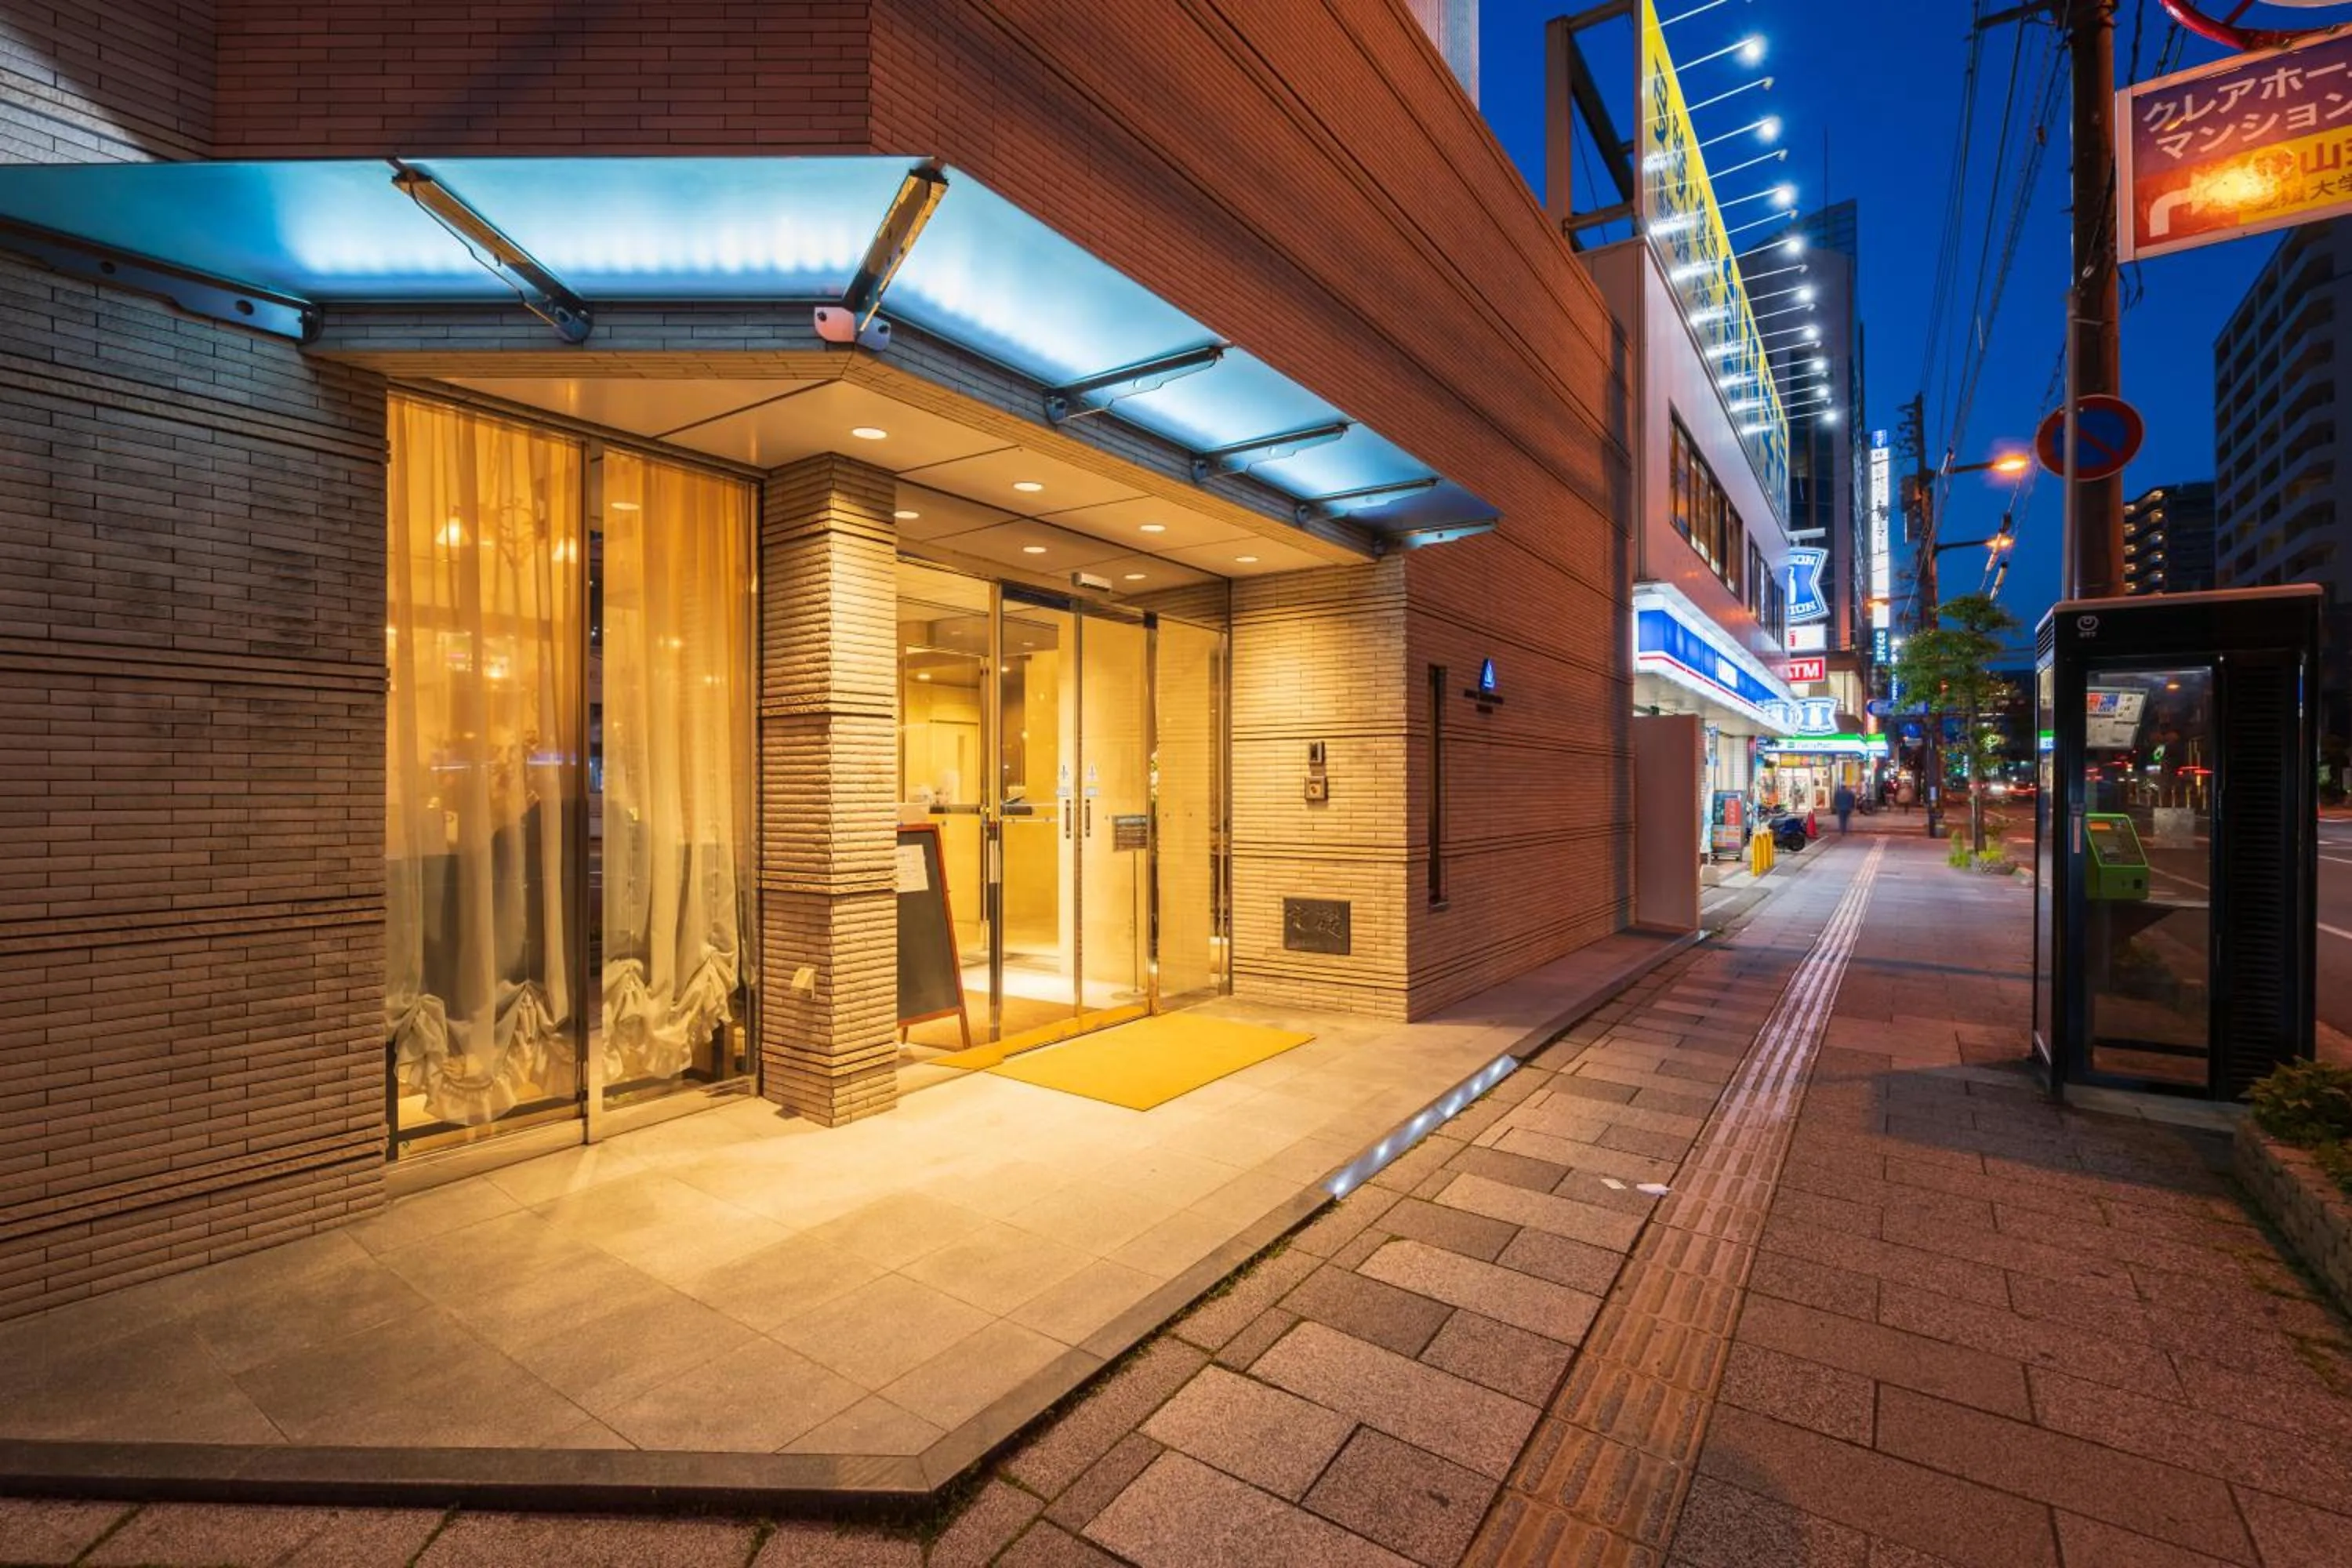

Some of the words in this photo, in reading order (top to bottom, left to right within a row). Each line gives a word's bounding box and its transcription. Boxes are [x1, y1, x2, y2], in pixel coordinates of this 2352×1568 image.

[2143, 62, 2352, 133] クレアホー
